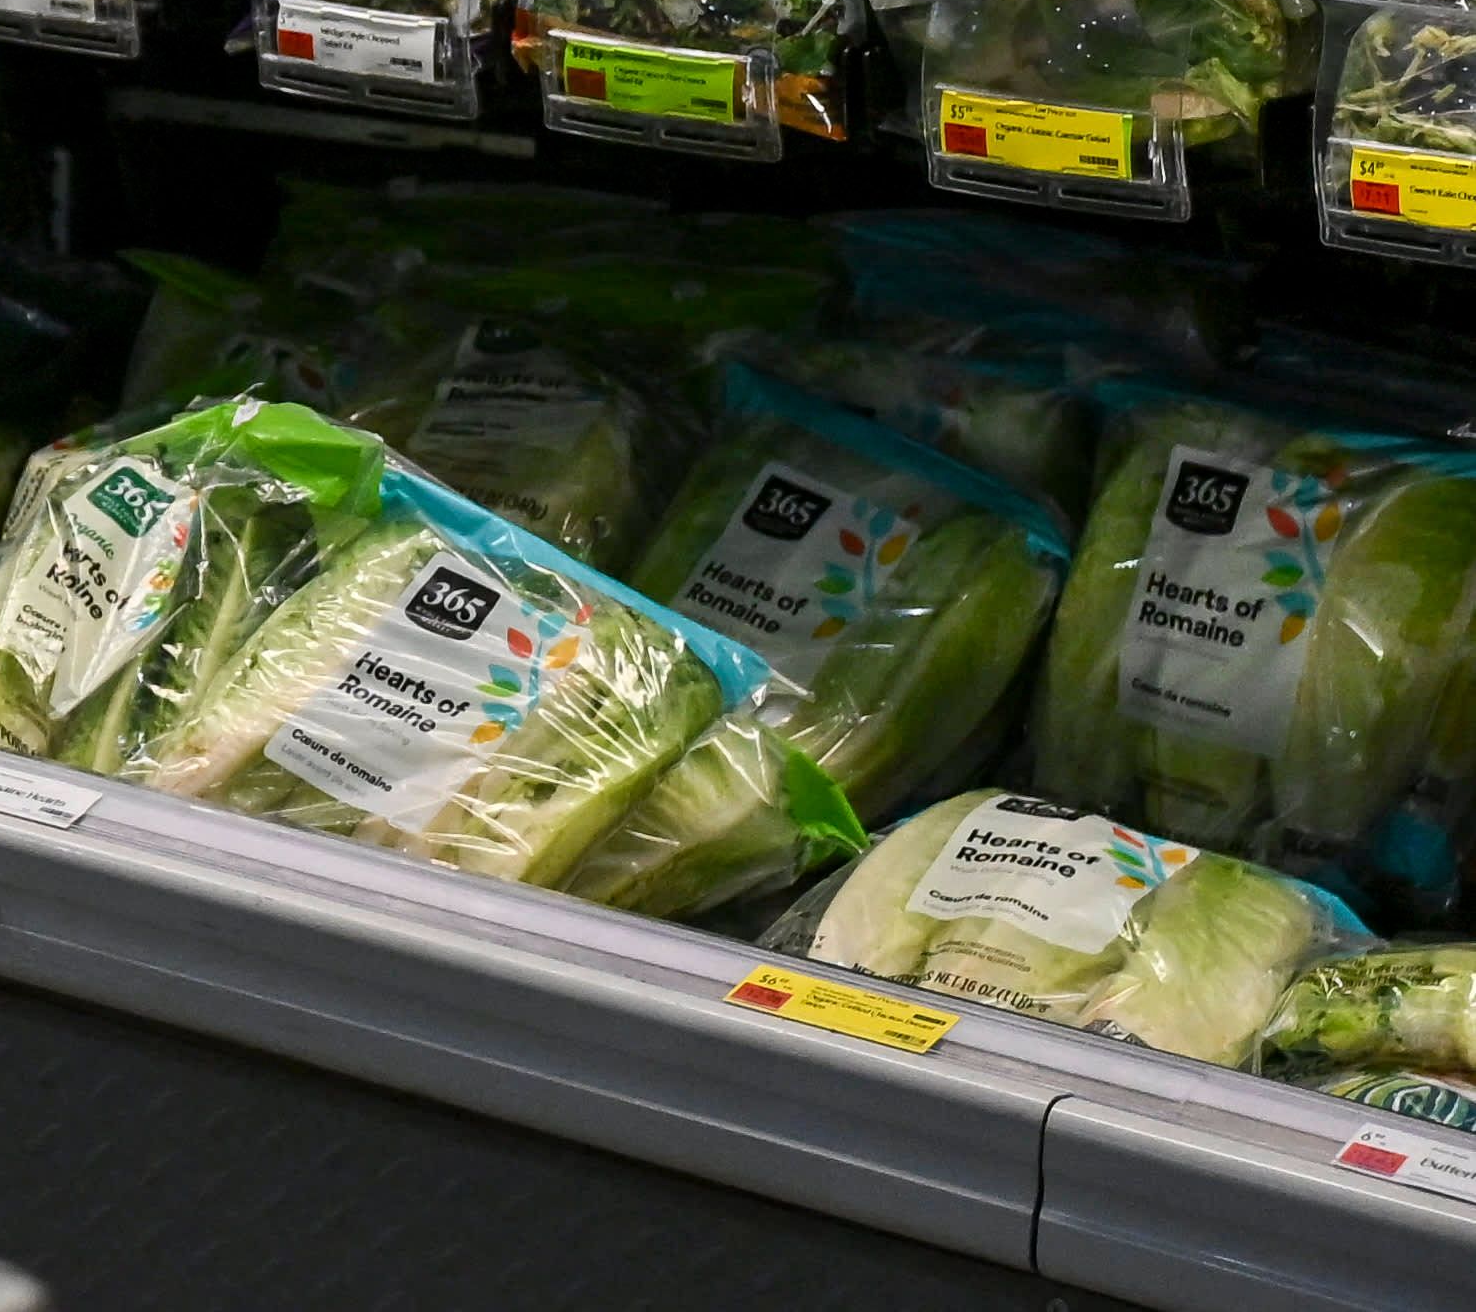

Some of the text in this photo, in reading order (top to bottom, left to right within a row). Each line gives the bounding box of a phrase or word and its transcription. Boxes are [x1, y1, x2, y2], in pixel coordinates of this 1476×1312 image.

[754, 486, 819, 526] 365
[1177, 472, 1241, 515] 365
[423, 581, 487, 624] 365
[684, 586, 781, 636] Romaine
[699, 559, 809, 618] Hearts of
[1145, 572, 1265, 622] Hearts of
[1138, 605, 1246, 651] Romaine
[337, 674, 437, 732] Romaine
[355, 651, 470, 718] Hearts of
[291, 728, 393, 792] Cœurs de romaine
[956, 847, 1076, 878] Romaine
[967, 828, 1102, 865] Hearts of
[975, 893, 993, 902] de
[994, 896, 1049, 921] romaine
